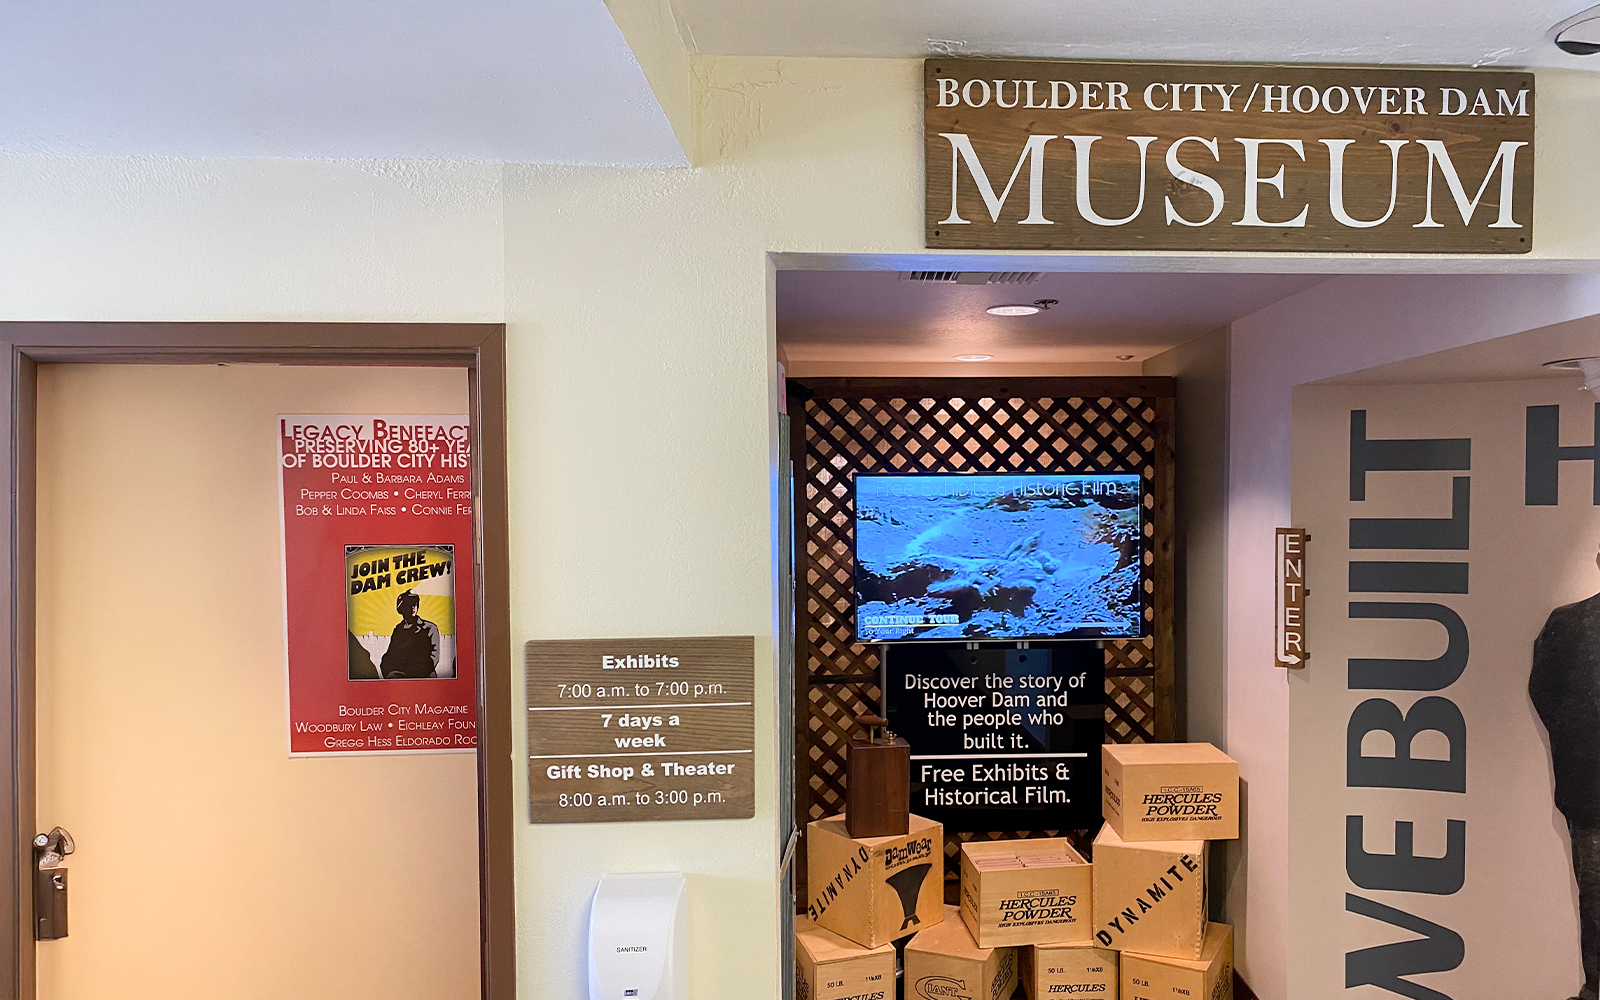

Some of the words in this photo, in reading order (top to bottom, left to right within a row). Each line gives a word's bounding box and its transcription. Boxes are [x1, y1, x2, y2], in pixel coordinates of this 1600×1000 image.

[935, 78, 1132, 112] BOULDER
[1143, 82, 1430, 116] CITY/HOOVER
[1438, 87, 1531, 118] DAM
[936, 132, 1530, 230] MUSEUM
[281, 418, 363, 440] LEGACY
[295, 440, 403, 454] PRESERVING
[408, 440, 440, 454] 80+
[283, 453, 306, 468] OF
[312, 453, 391, 468] BOULDER
[397, 453, 436, 468] CITY
[331, 472, 358, 484] PAUL
[362, 472, 372, 484] &
[376, 472, 423, 484] BARBARA
[426, 472, 465, 484] ADAMS
[301, 488, 337, 500] PEPPER
[341, 488, 389, 500] COOMBS
[404, 488, 443, 500] CHERYL
[876, 480, 915, 497] Free
[922, 479, 988, 498] Exhibits
[1013, 479, 1079, 498] Historic
[1082, 479, 1117, 497] Film
[296, 504, 318, 516] BOB
[322, 504, 332, 516] &
[336, 504, 367, 516] LINDA
[370, 504, 396, 516] FAISS
[412, 503, 453, 515] CONNIE
[350, 557, 390, 580] JOIN
[392, 550, 427, 571] THE
[350, 573, 391, 596] DAM
[396, 561, 451, 586] CREW!
[1285, 534, 1302, 652] ENTER
[1346, 410, 1471, 794] BUILT
[863, 614, 924, 625] CONTINUE
[929, 613, 960, 624] TOUR
[864, 626, 874, 635] To
[875, 626, 893, 636] Your
[895, 626, 915, 636] Right
[602, 654, 680, 669] Exhibits
[557, 684, 591, 698] 7:00
[596, 686, 630, 697] a.m.
[635, 683, 649, 696] to
[655, 681, 689, 696] 7:00
[694, 683, 727, 698] p.m.
[905, 673, 979, 690] Discover
[985, 672, 1014, 689] the
[1019, 675, 1063, 692] story
[1068, 672, 1087, 688] of
[924, 692, 986, 708] Hoover
[992, 692, 1030, 707] Dam
[1036, 691, 1068, 707] and
[339, 705, 384, 716] BOULDER
[388, 704, 411, 715] CITY
[414, 703, 468, 715] MAGAZINE
[295, 721, 356, 733] WOODBURY
[360, 720, 383, 731] LAW
[398, 719, 445, 731] EICHLEAY
[448, 718, 476, 730] FOUN
[601, 714, 613, 728] 7
[618, 713, 663, 730] days
[668, 715, 680, 726] a
[927, 710, 956, 727] the
[963, 709, 1022, 730] people
[1027, 709, 1064, 725] who
[324, 737, 364, 749] GREGG
[368, 736, 392, 747] HESS
[395, 735, 451, 747] ELDORADO
[614, 734, 666, 748] week
[963, 733, 1004, 749] built
[1010, 733, 1029, 749] it.
[546, 764, 582, 780] Gift
[587, 764, 634, 780] Shop
[640, 763, 655, 777] &
[660, 762, 735, 777] Theater
[921, 764, 965, 783] Free
[972, 763, 1048, 782] Exhibits
[1056, 762, 1071, 781] &
[559, 793, 592, 807] 8:00
[597, 794, 630, 807] a.m.
[635, 792, 650, 805] to
[654, 790, 688, 805] 3:00
[693, 791, 726, 807] p.m.
[925, 786, 1018, 806] Historical
[1025, 785, 1071, 804] Film.
[1142, 793, 1222, 806] HERCULES
[1146, 804, 1218, 816] POWDER
[808, 846, 869, 922] DYNAMITE
[999, 895, 1077, 911] HERCULES
[1096, 854, 1198, 947] DYNAMITE
[1002, 908, 1073, 922] POWDER
[1048, 983, 1106, 994] HERCULES
